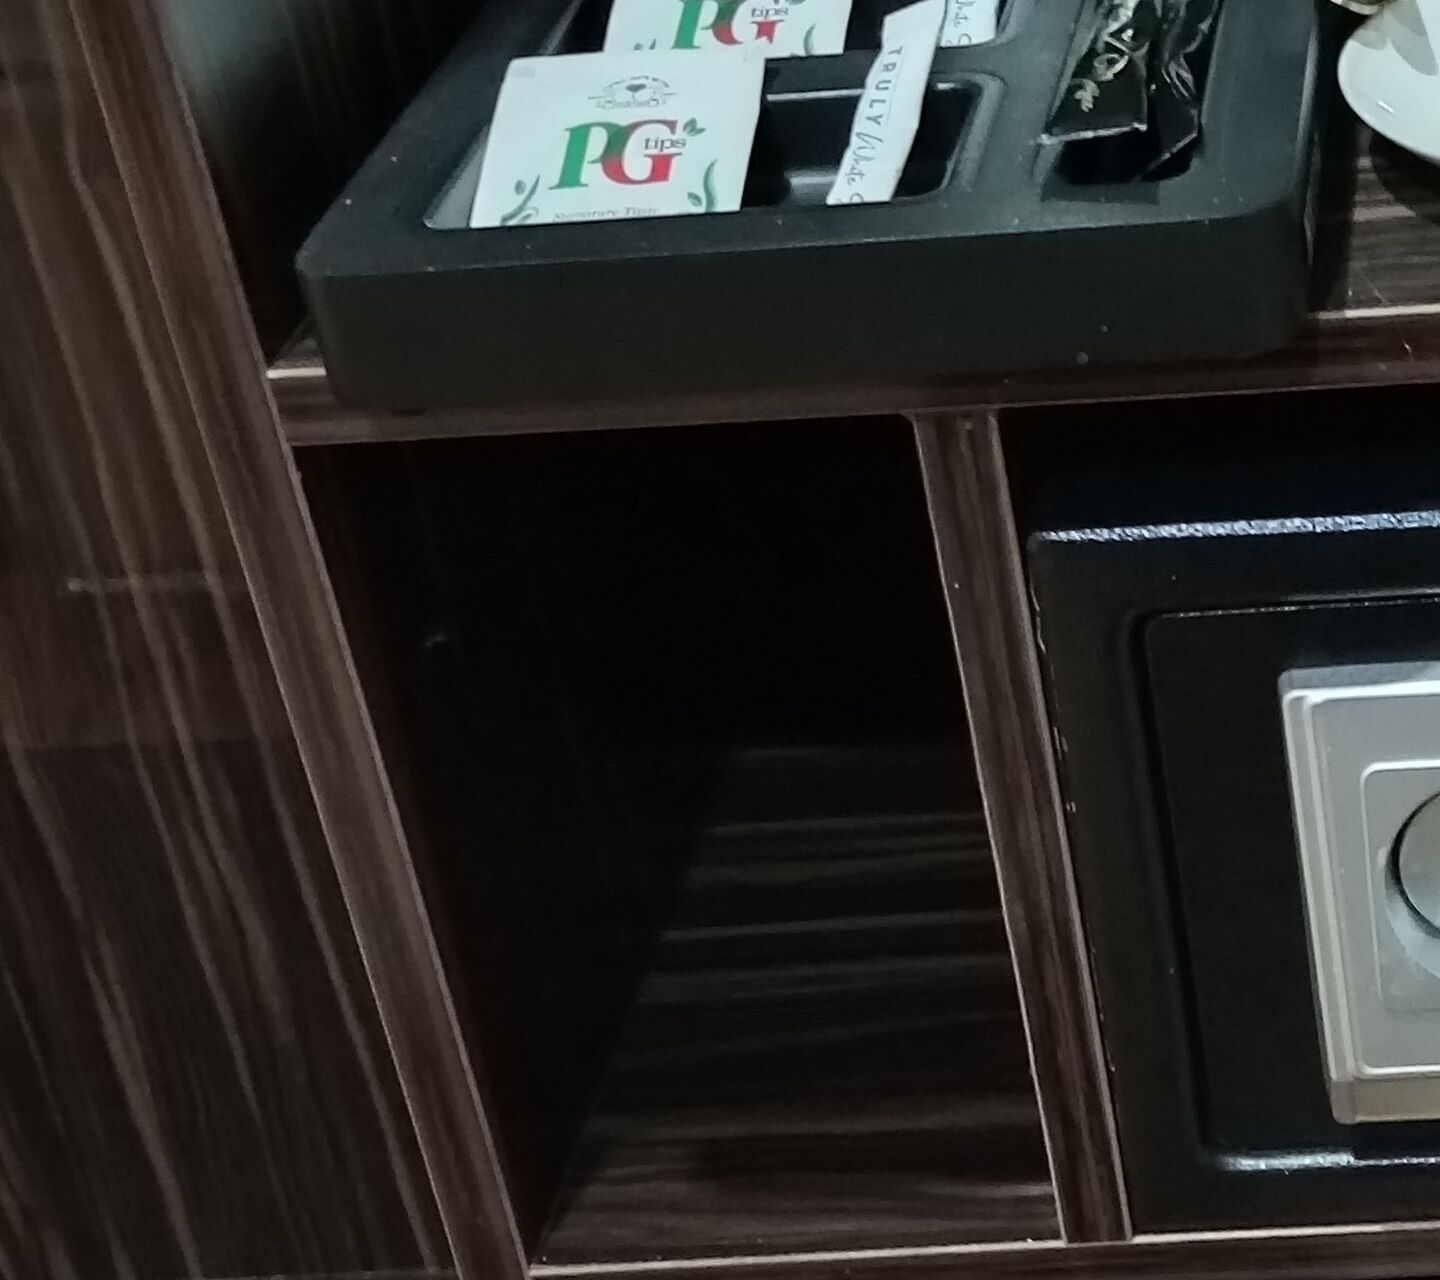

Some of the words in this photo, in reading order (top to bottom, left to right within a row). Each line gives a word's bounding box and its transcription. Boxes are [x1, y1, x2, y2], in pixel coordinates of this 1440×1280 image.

[750, 4, 789, 22] tips
[864, 45, 904, 126] TRULY
[547, 119, 683, 191] PG
[643, 136, 687, 153] tips
[845, 132, 885, 187] White
